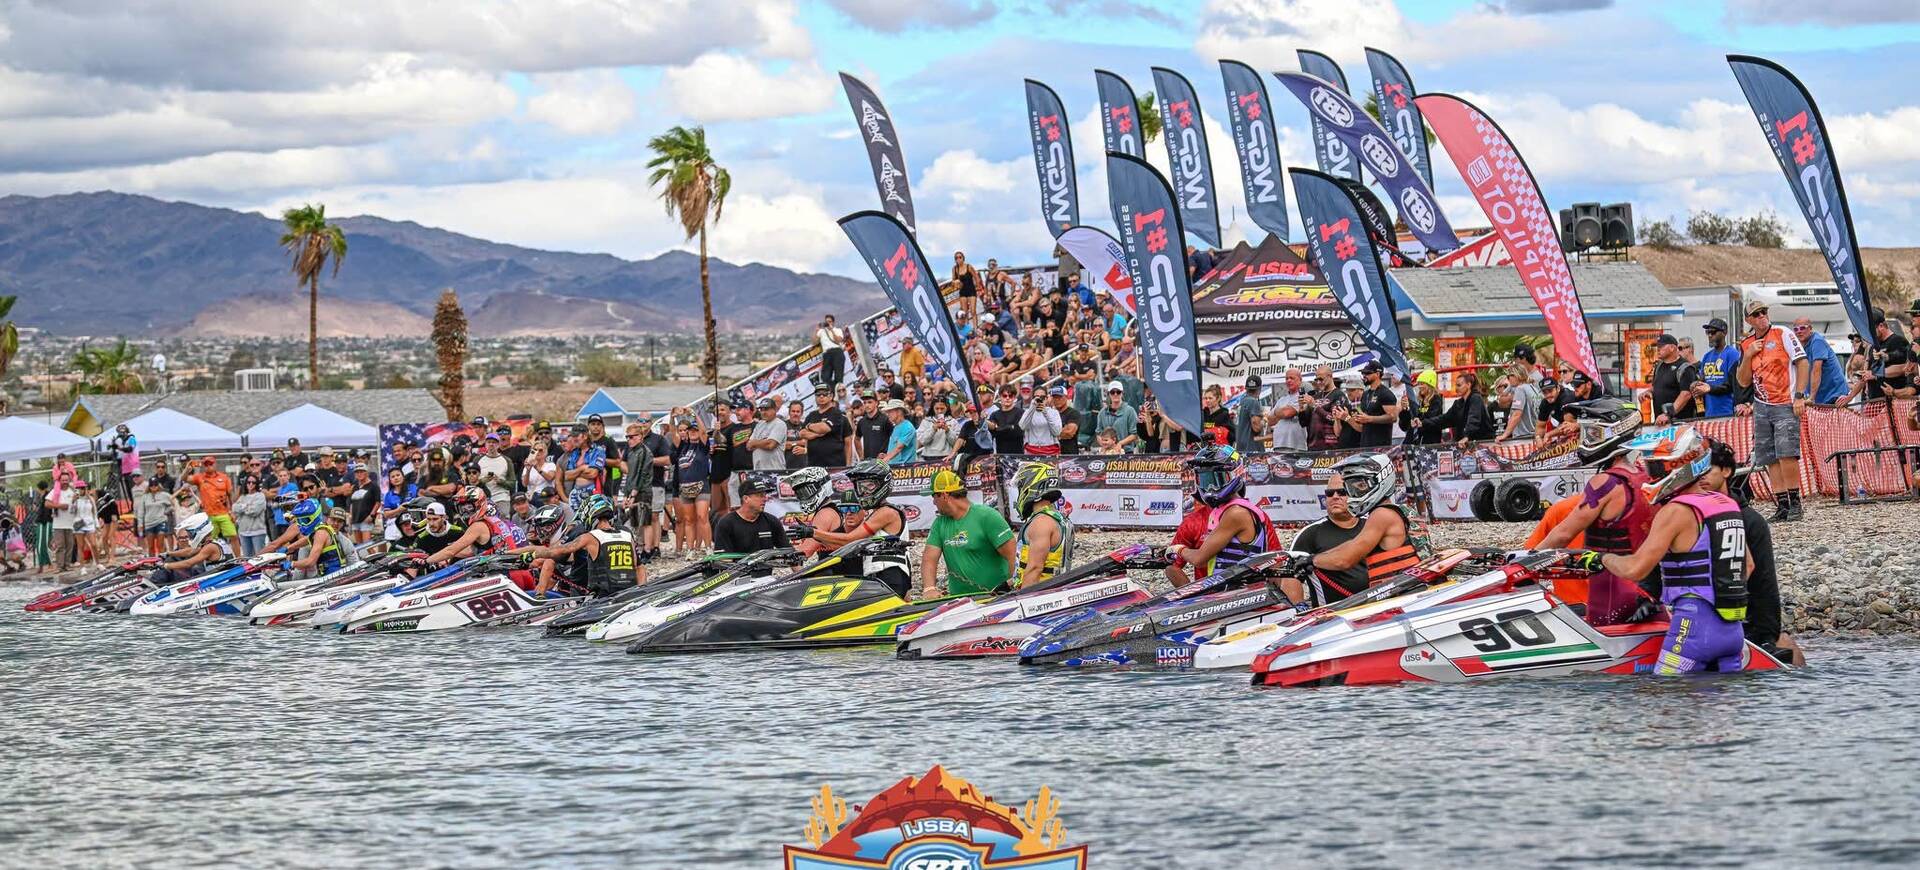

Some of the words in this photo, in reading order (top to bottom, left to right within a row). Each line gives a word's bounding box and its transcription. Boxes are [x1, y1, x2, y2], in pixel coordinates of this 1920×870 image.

[1228, 368, 1244, 378] The
[1248, 363, 1286, 377] Impeller
[1106, 461, 1128, 472] IJSBA
[1129, 460, 1155, 472] WORLD
[1155, 460, 1182, 472] FINALS
[892, 478, 920, 486] ORLD
[1048, 478, 1059, 488] 27
[1150, 501, 1176, 511] RIVA
[1719, 528, 1746, 560] 90
[608, 550, 633, 566] 116
[801, 580, 862, 607] 27
[1035, 600, 1063, 613] JETPILOT
[1068, 590, 1102, 606] TANAWIN
[1102, 582, 1129, 597] MOLEE
[467, 590, 522, 620] 851
[1168, 609, 1201, 625] FAST
[1200, 593, 1268, 616] POWERSPORTS
[383, 619, 419, 630] MONSTER
[1458, 608, 1558, 653] 90
[1158, 647, 1190, 659] LIQUI
[1404, 653, 1421, 663] USG
